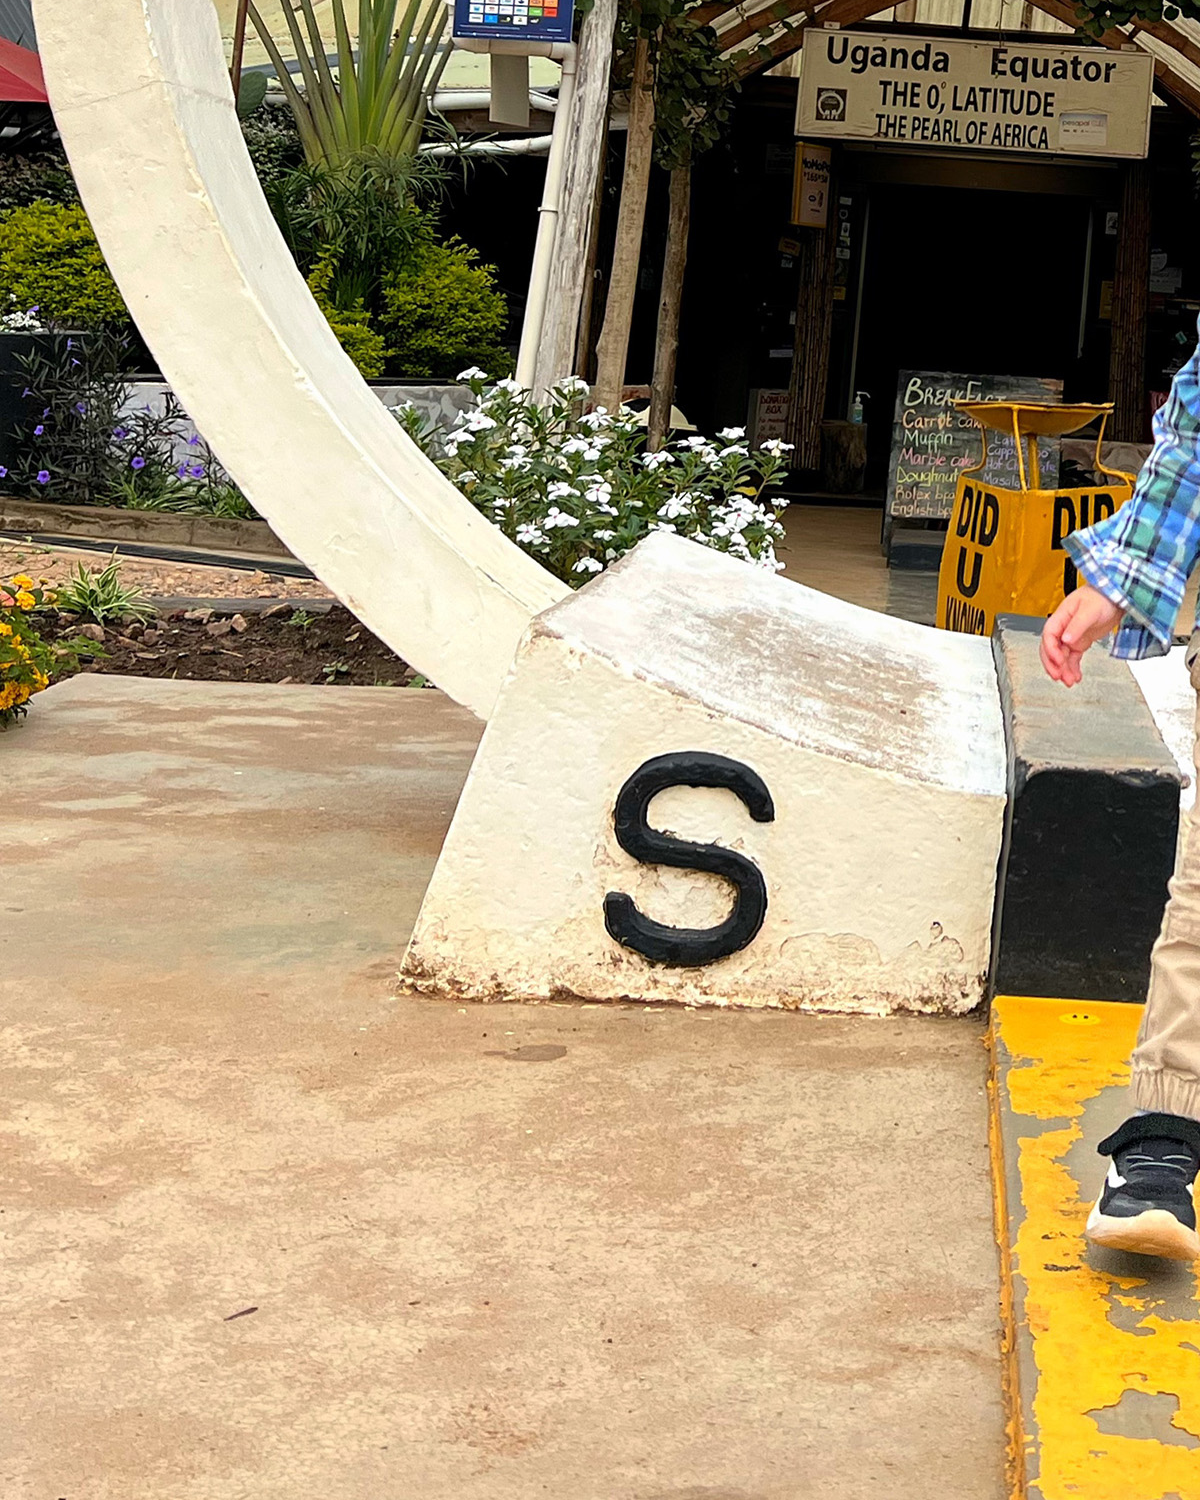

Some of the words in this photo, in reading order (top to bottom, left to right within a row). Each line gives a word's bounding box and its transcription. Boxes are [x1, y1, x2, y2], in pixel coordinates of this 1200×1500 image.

[827, 36, 950, 74] Uganda
[991, 48, 1117, 83] Equator
[878, 80, 921, 109] THE
[952, 85, 1055, 117] LATITUDE
[875, 113, 907, 138] THE
[911, 116, 961, 143] PEARL
[966, 121, 988, 145] OF
[991, 122, 1049, 149] AFRICA
[902, 408, 953, 430] Carrot
[897, 447, 946, 467] Marble
[902, 429, 953, 453] Muffin
[890, 500, 933, 517] English
[956, 485, 1000, 547] DID
[956, 546, 983, 598] U
[603, 751, 774, 967] S
